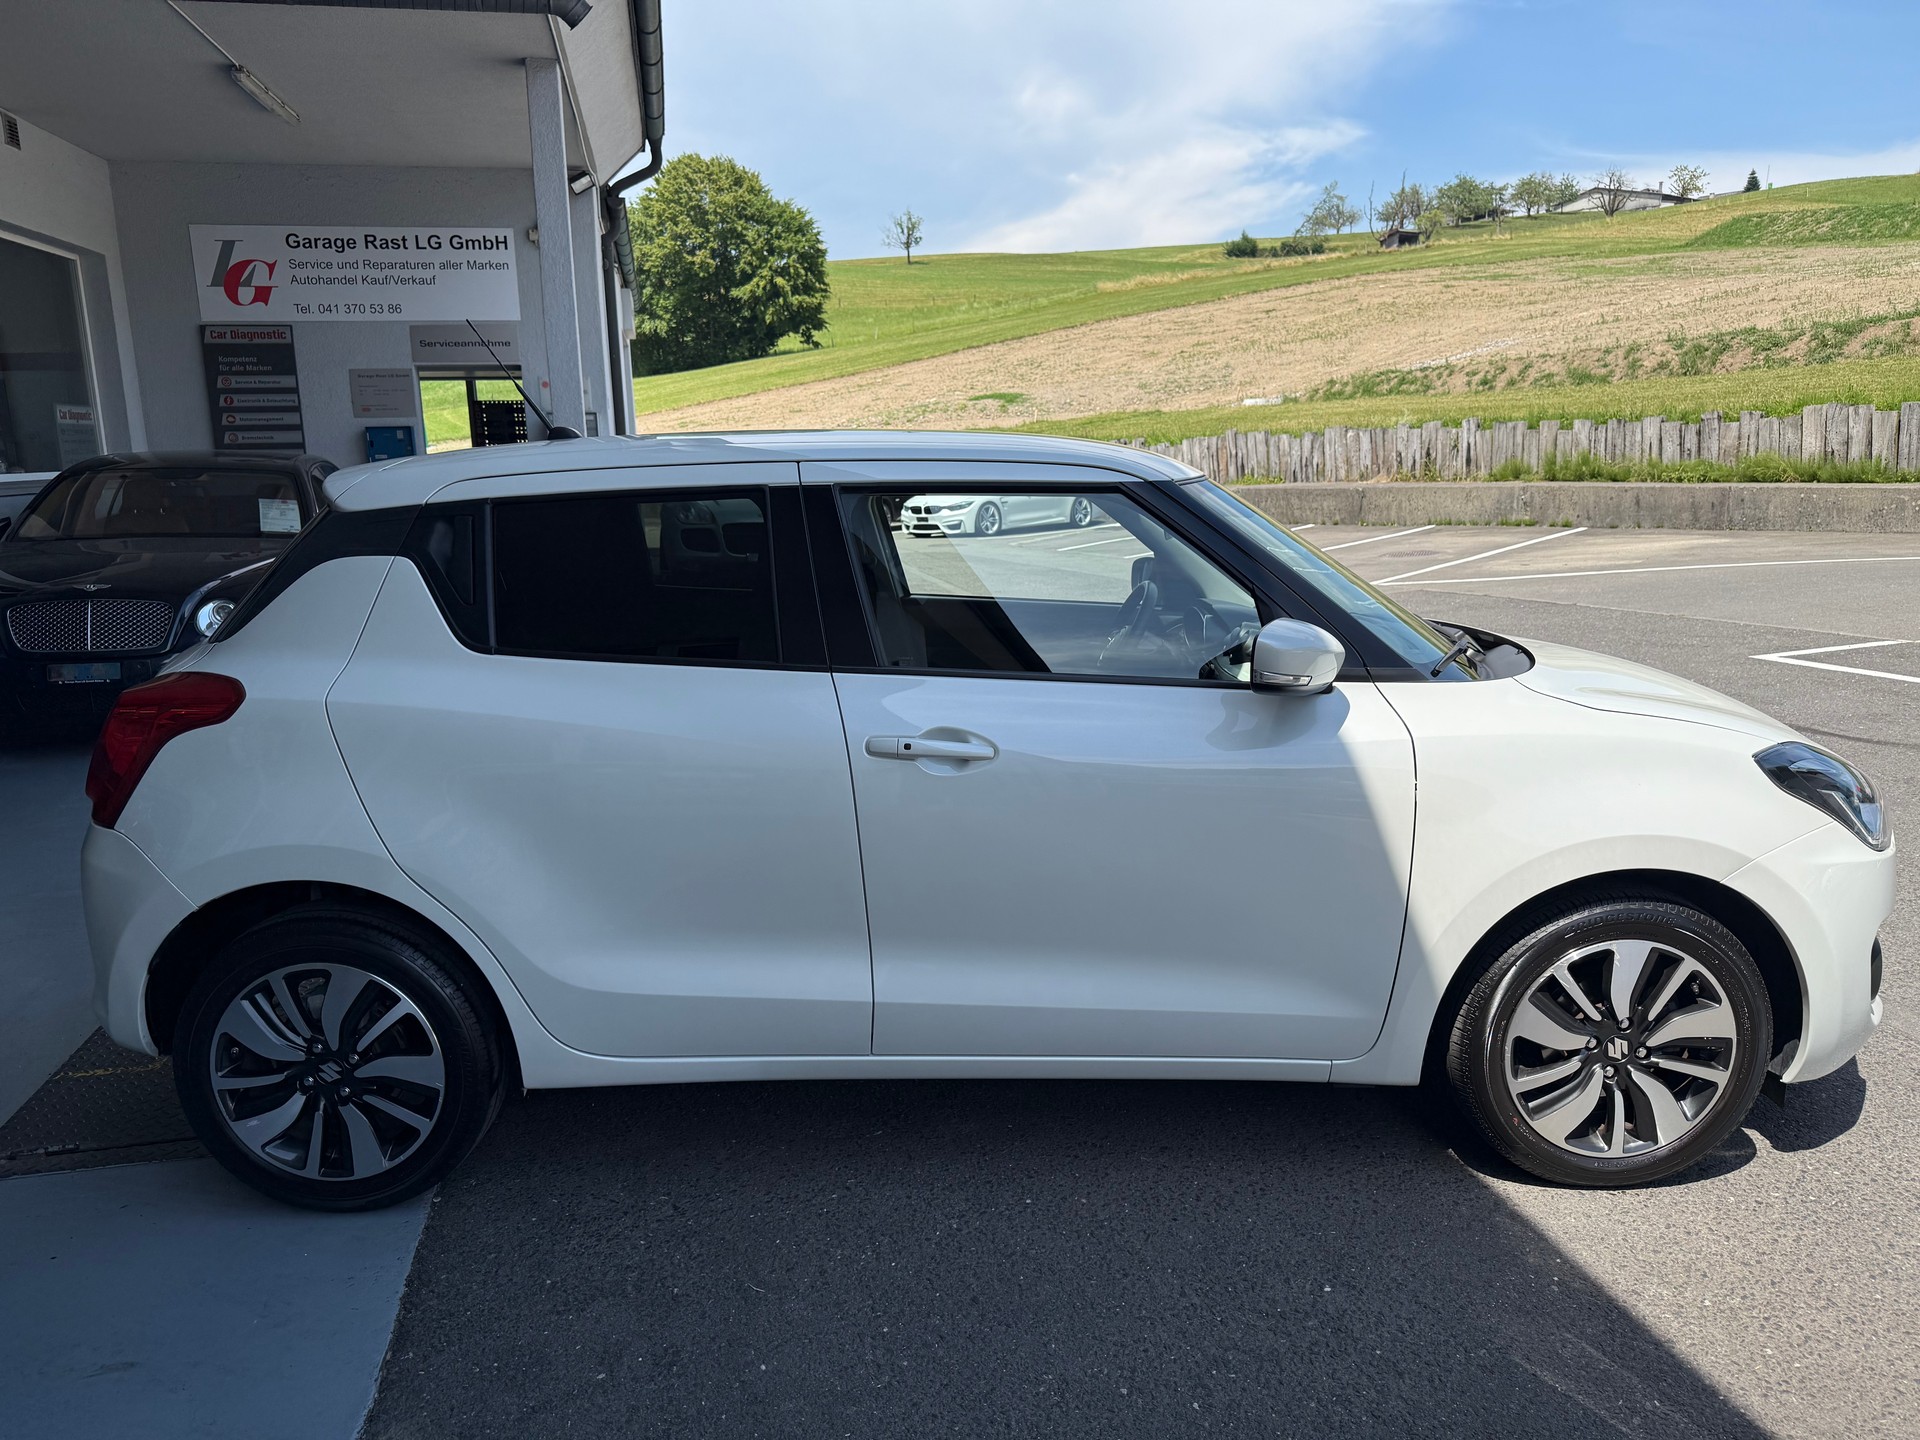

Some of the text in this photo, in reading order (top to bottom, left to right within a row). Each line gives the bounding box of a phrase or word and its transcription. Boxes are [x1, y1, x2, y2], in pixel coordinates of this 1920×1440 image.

[285, 233, 509, 254] Garage Rast LG GmbH
[288, 259, 510, 273] Service und Reparaturen aller Marken
[290, 275, 437, 286] Autohandel Kauf/Verkauf
[293, 303, 403, 315] Tel. 041 370 53 86
[210, 329, 287, 341] Car Diagnostic
